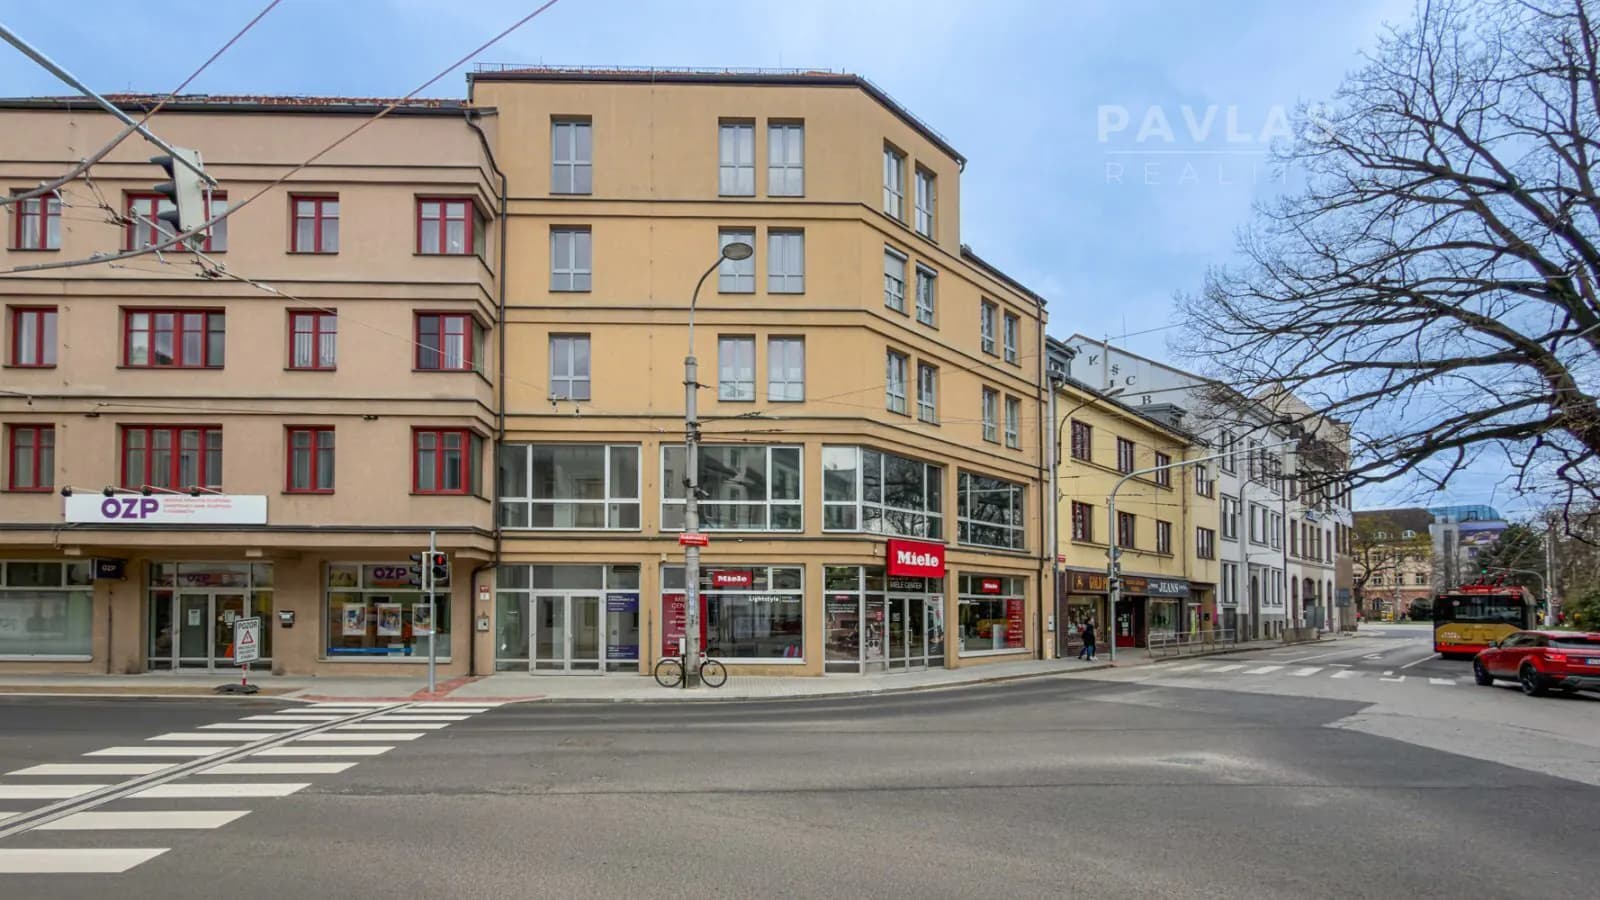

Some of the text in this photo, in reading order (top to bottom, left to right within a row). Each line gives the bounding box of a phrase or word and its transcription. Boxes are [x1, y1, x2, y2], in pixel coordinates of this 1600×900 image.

[101, 497, 159, 519] OZP
[896, 550, 940, 568] Miele
[373, 567, 407, 579] OZP
[717, 575, 748, 583] Miele
[748, 595, 779, 603] Lightstyle
